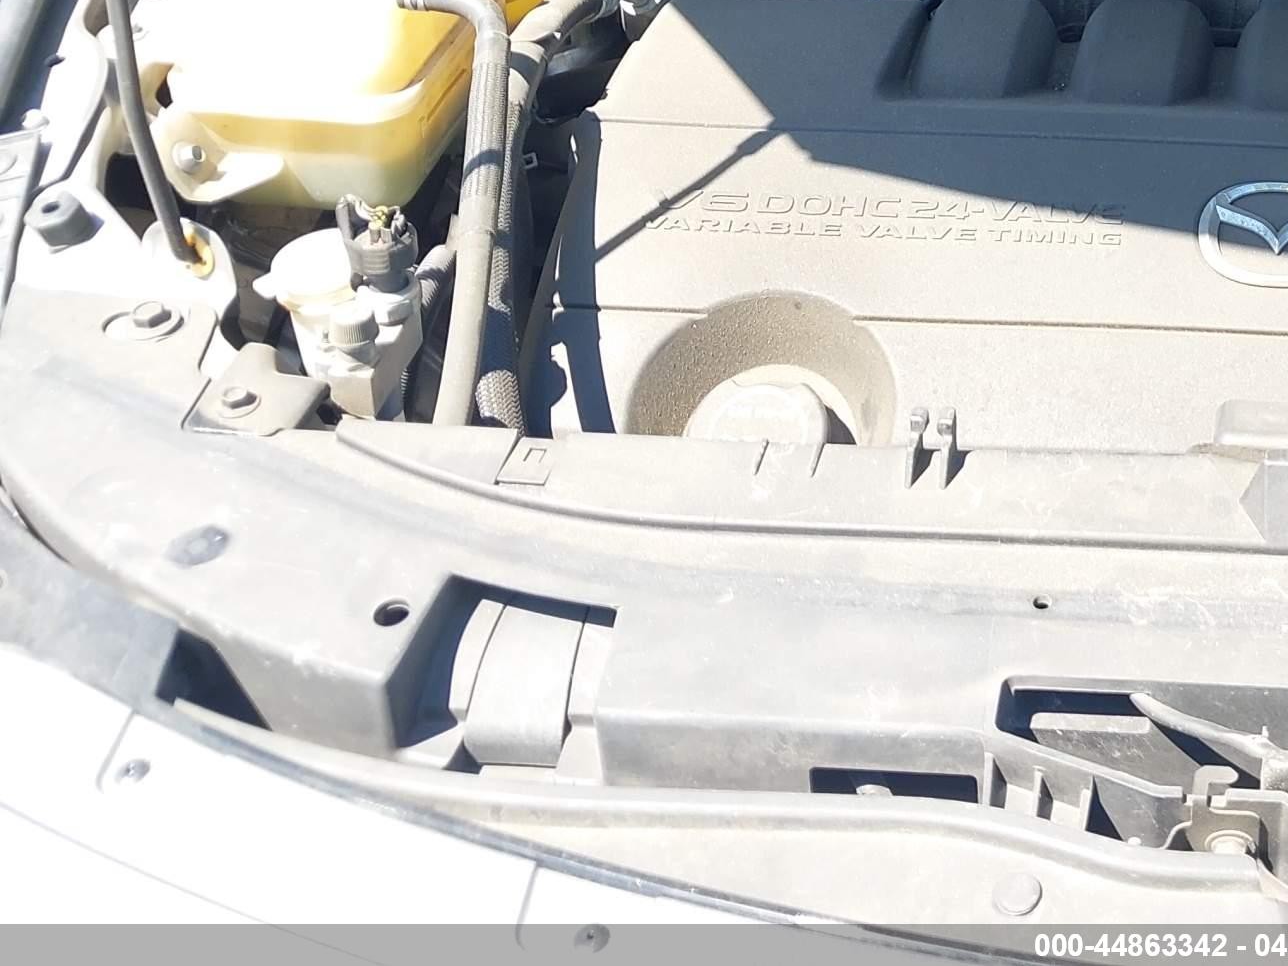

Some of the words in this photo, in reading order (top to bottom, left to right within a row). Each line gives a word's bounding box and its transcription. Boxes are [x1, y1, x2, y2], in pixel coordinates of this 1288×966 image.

[660, 187, 750, 213] V6
[756, 195, 902, 219] DOHC
[906, 200, 1125, 226] 24-VALVE
[646, 215, 842, 237] VARIABLE
[859, 224, 977, 241] VALVE
[986, 229, 1122, 246] TIMING
